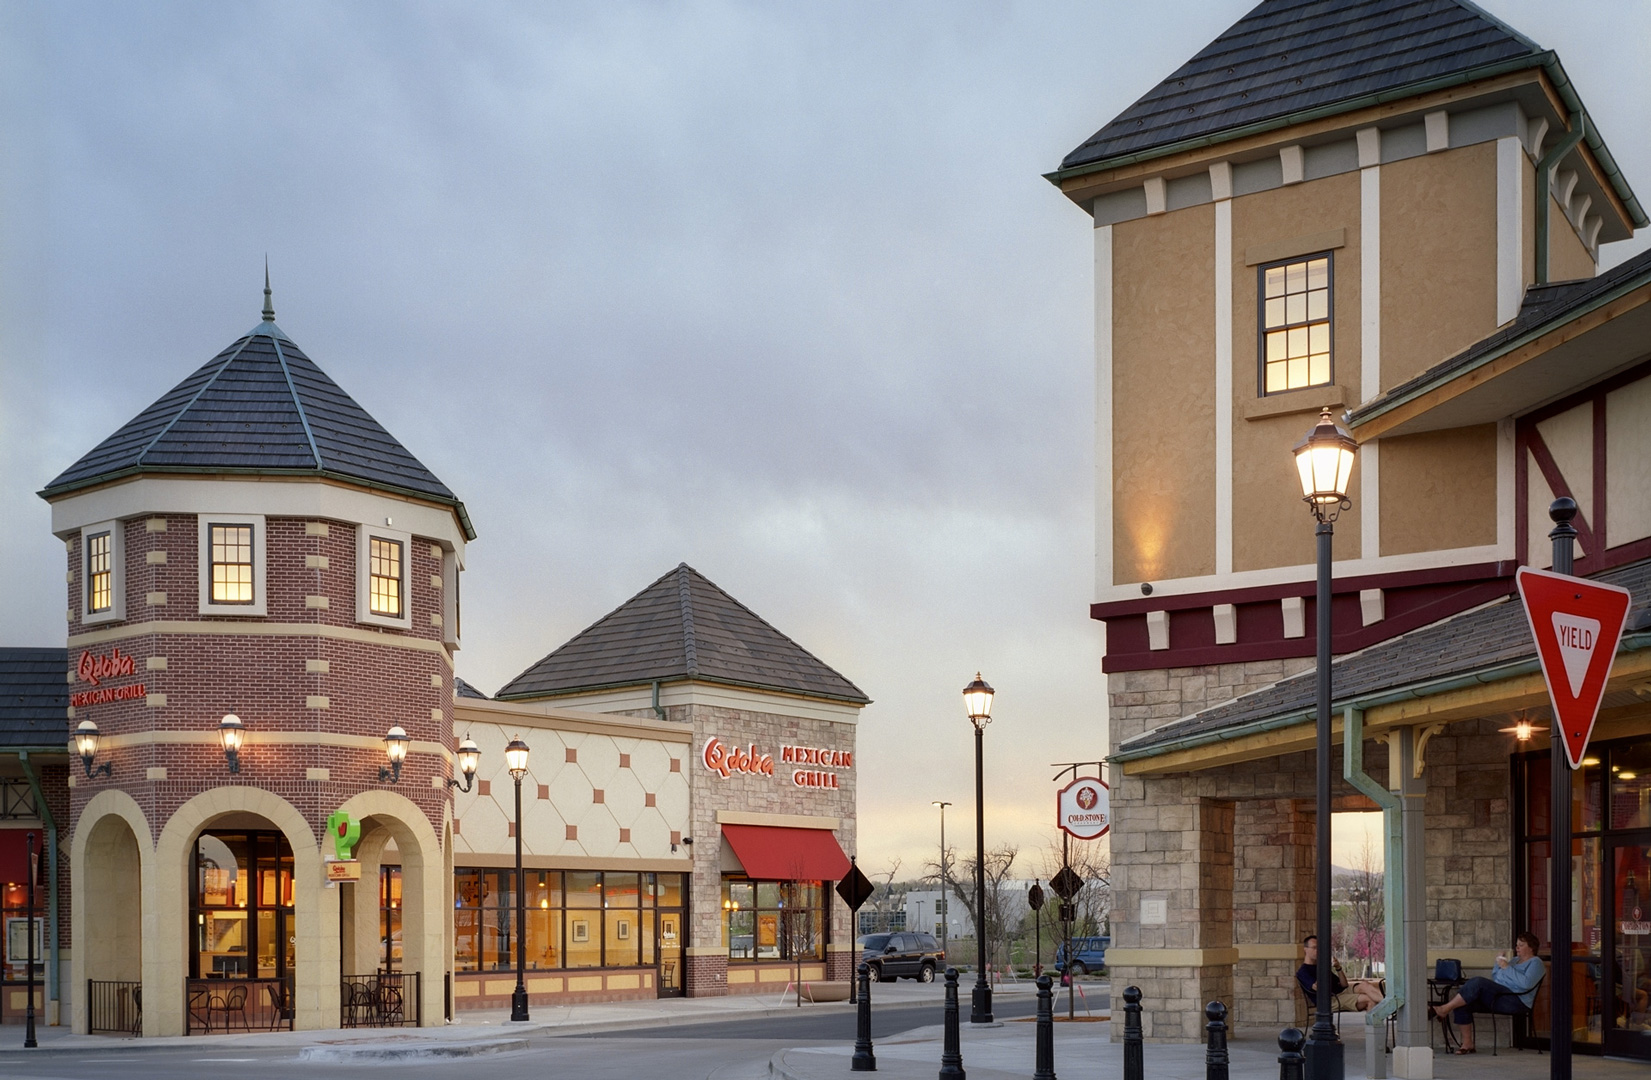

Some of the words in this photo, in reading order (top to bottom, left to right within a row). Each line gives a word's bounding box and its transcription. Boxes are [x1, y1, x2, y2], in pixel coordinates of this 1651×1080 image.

[1559, 624, 1592, 651] YIELD
[77, 648, 135, 686] Qdoba
[71, 688, 115, 707] MEXICAN
[115, 683, 148, 700] GRILL
[701, 735, 775, 779] Qdoba
[780, 744, 853, 769] MEXICAN
[792, 768, 840, 790] GRILL
[1068, 814, 1084, 824] COLD
[1084, 813, 1105, 823] STONE
